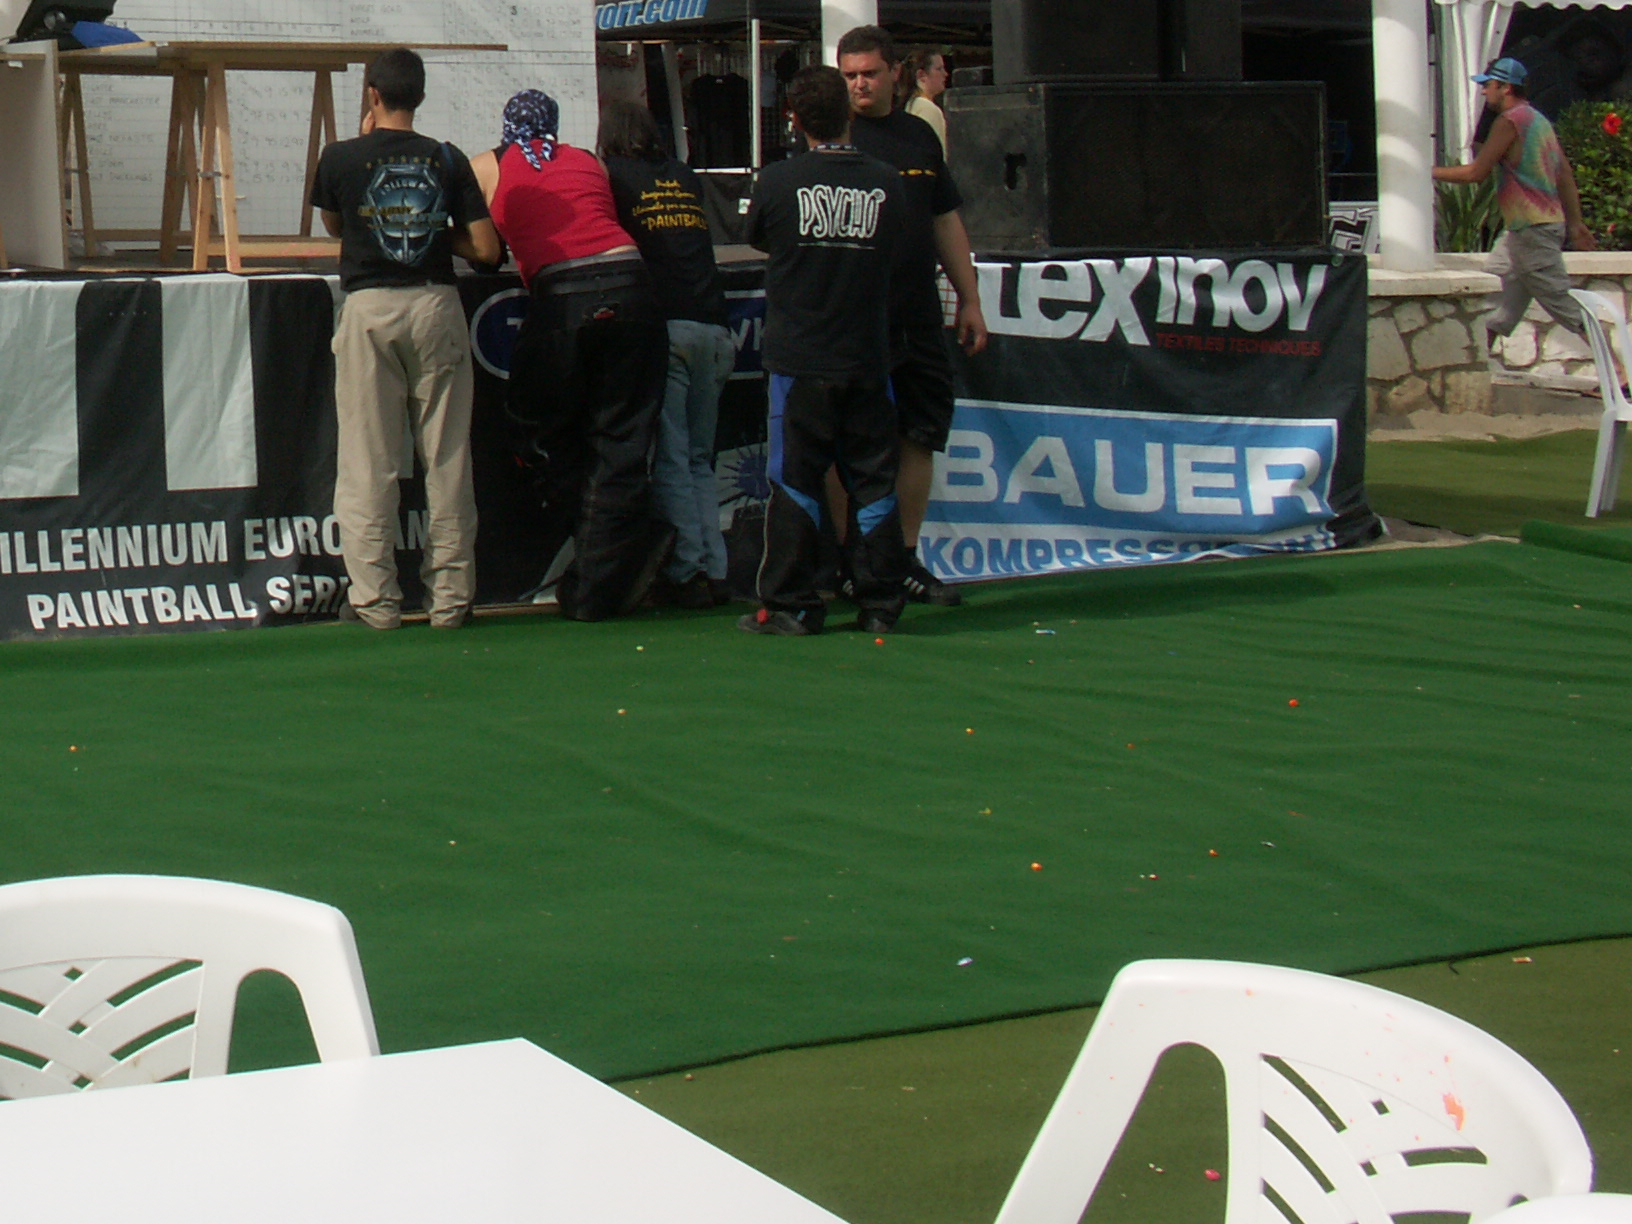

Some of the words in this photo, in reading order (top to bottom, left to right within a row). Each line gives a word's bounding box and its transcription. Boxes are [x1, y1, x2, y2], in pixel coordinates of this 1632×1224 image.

[797, 184, 887, 239] PSYCHO
[1155, 331, 1226, 353] TEXTILES
[1229, 337, 1322, 358] TECHNIQUES
[928, 428, 1323, 517] BAUER
[27, 581, 257, 631] PAINTBALL
